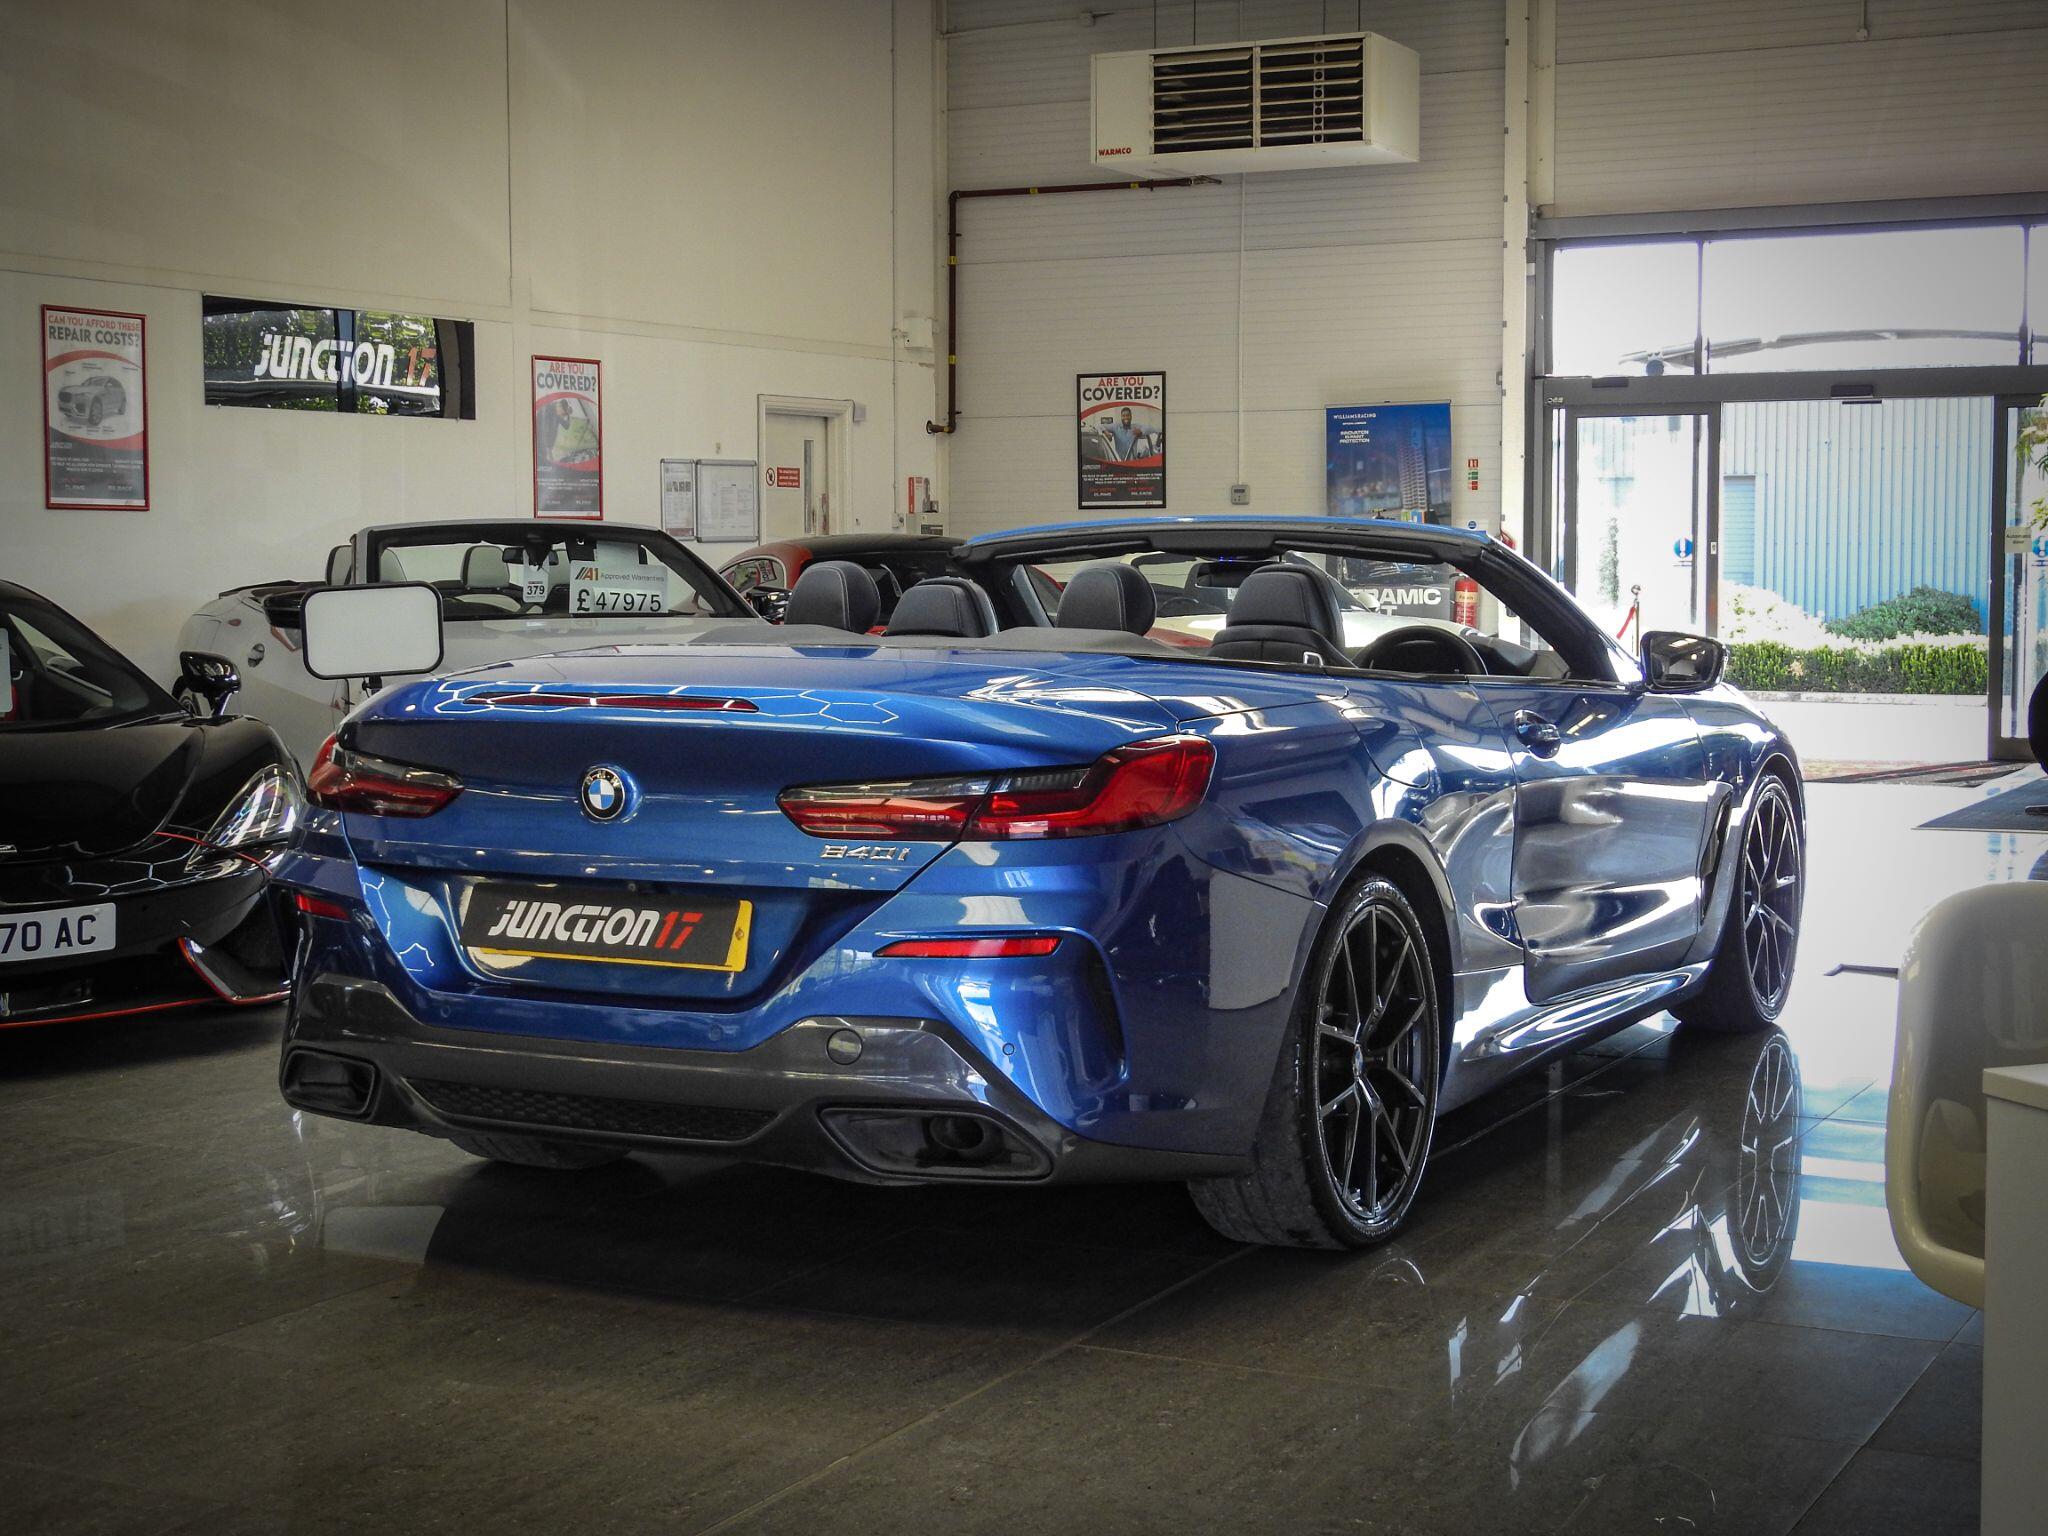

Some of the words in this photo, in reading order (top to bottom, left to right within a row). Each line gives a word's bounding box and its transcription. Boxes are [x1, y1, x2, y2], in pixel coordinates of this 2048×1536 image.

[1098, 147, 1132, 156] WARMCO
[48, 315, 66, 325] CAN
[67, 316, 84, 326] YOU
[86, 318, 116, 330] AFFORD
[117, 321, 141, 332] THESE
[48, 325, 92, 343] REPAIR
[95, 329, 140, 347] COSTS?
[406, 346, 437, 387] 17
[549, 362, 565, 374] ARE
[567, 363, 585, 375] YOU
[537, 373, 597, 392] COVERED?
[1098, 377, 1119, 387] ARE
[1122, 376, 1144, 387] YOU
[1082, 385, 1160, 401] COVERED?
[527, 585, 545, 595] 379
[1349, 588, 1442, 605] RAMIC
[577, 588, 662, 612] £47975
[820, 844, 911, 861] 840i
[0, 920, 42, 954] 70
[54, 914, 97, 949] AC
